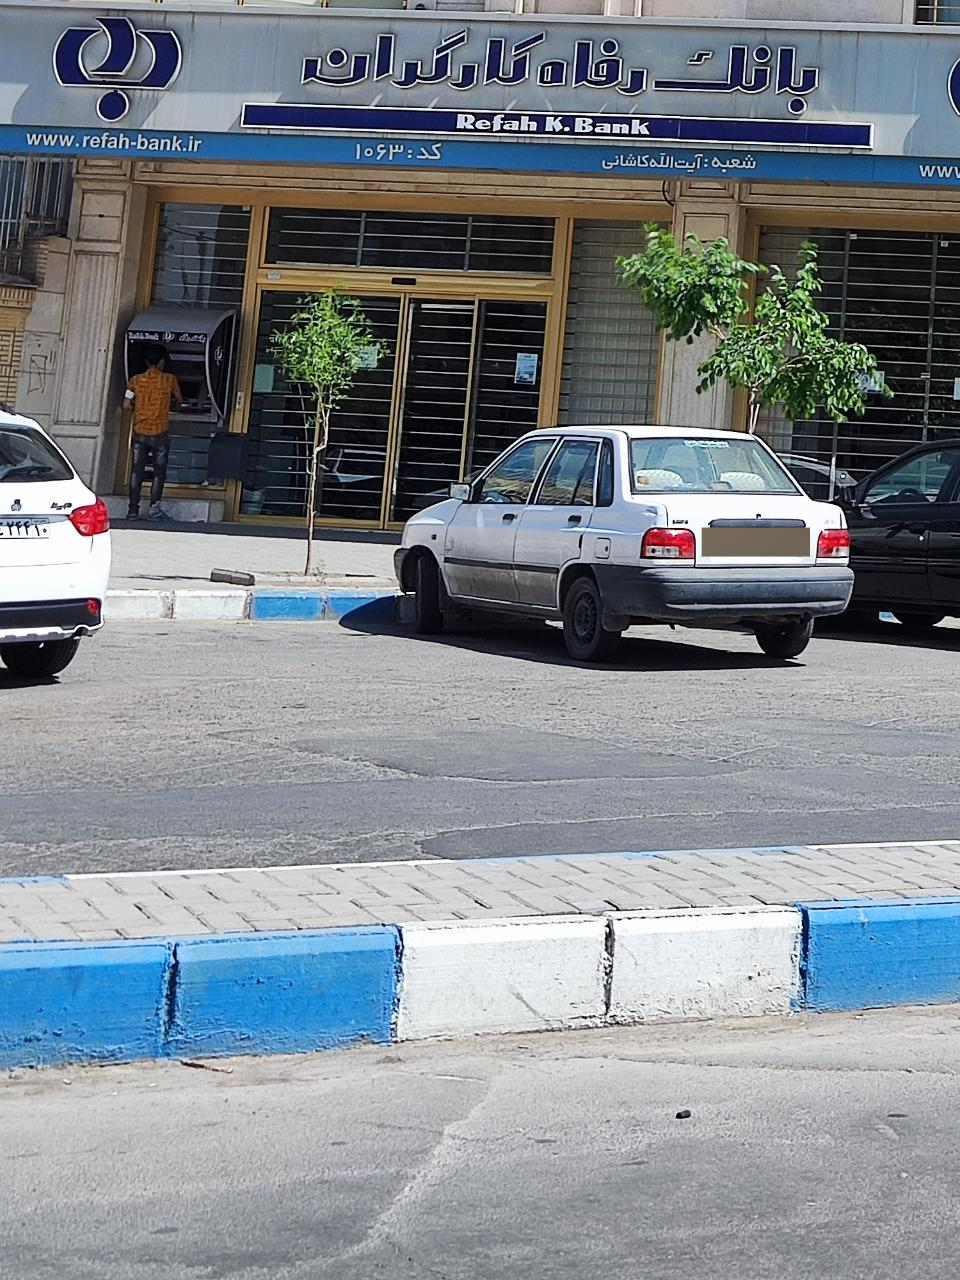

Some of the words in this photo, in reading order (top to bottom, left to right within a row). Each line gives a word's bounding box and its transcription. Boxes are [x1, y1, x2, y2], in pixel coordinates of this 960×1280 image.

[300, 28, 546, 90] کارگران
[536, 38, 648, 96] رفاه
[652, 44, 820, 116] بانک
[26, 132, 202, 152] www.refah-bank.ir
[456, 113, 538, 132] Refah
